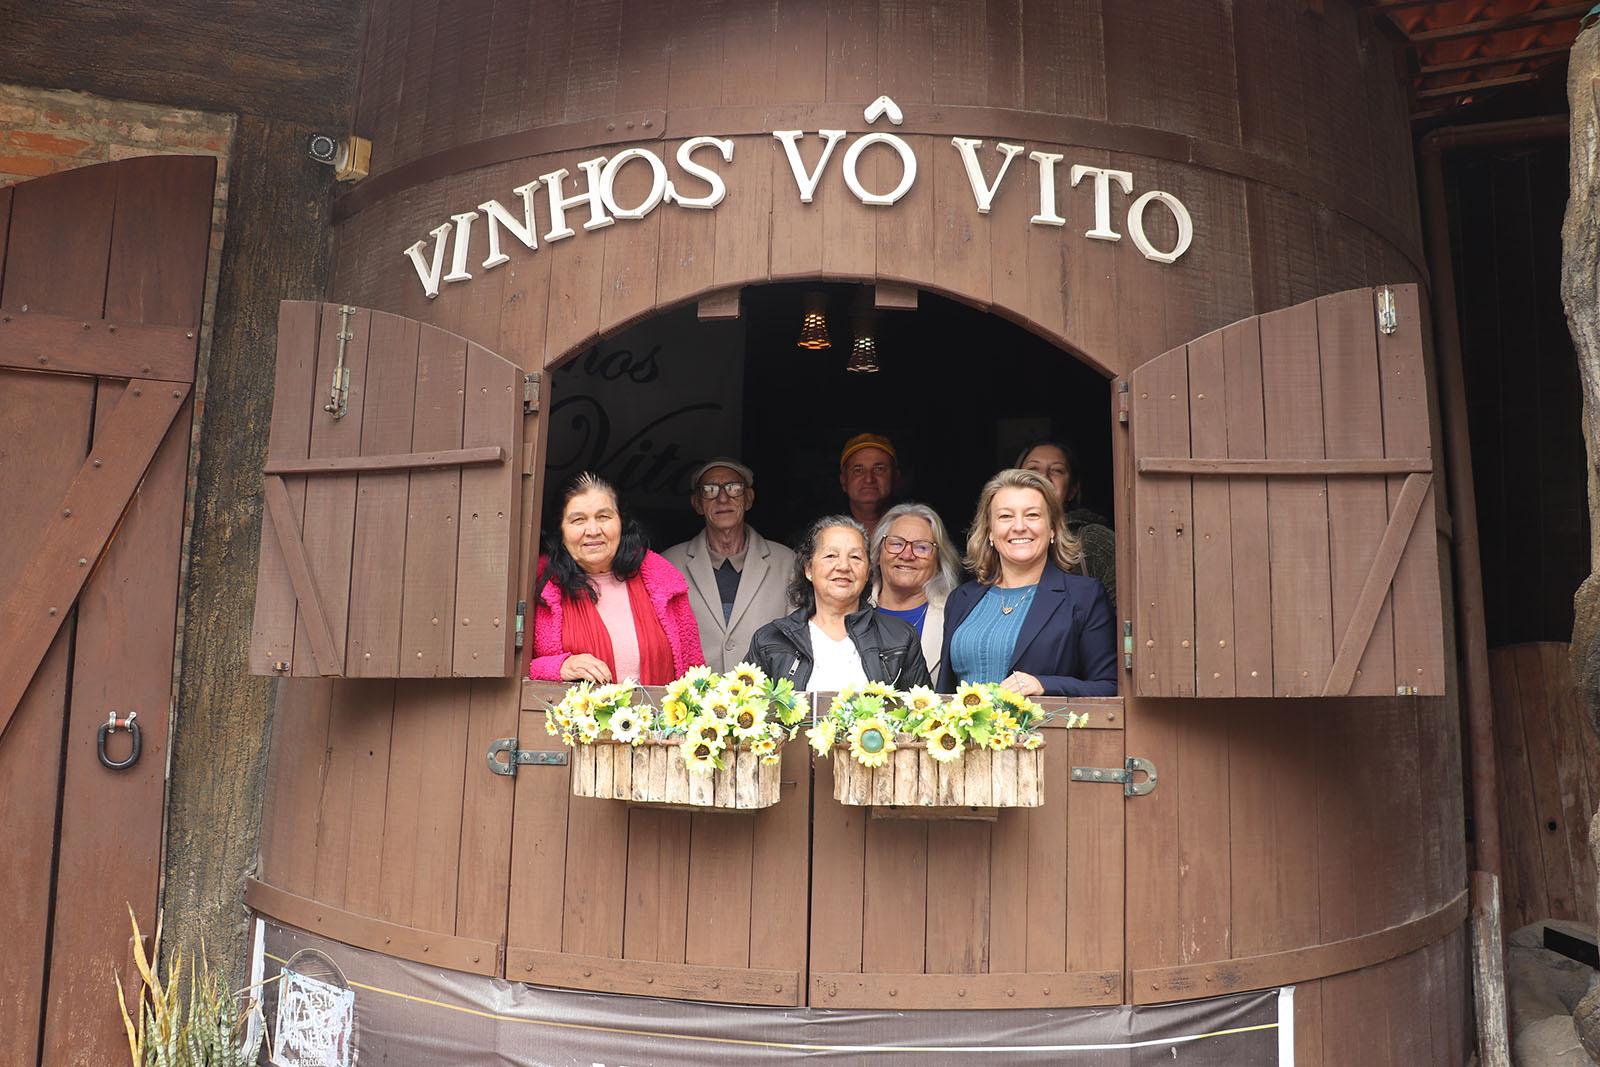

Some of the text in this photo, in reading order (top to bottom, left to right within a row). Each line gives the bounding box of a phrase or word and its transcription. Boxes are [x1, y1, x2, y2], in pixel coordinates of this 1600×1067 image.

[403, 95, 1193, 299] VINHOS VÔ VITO
